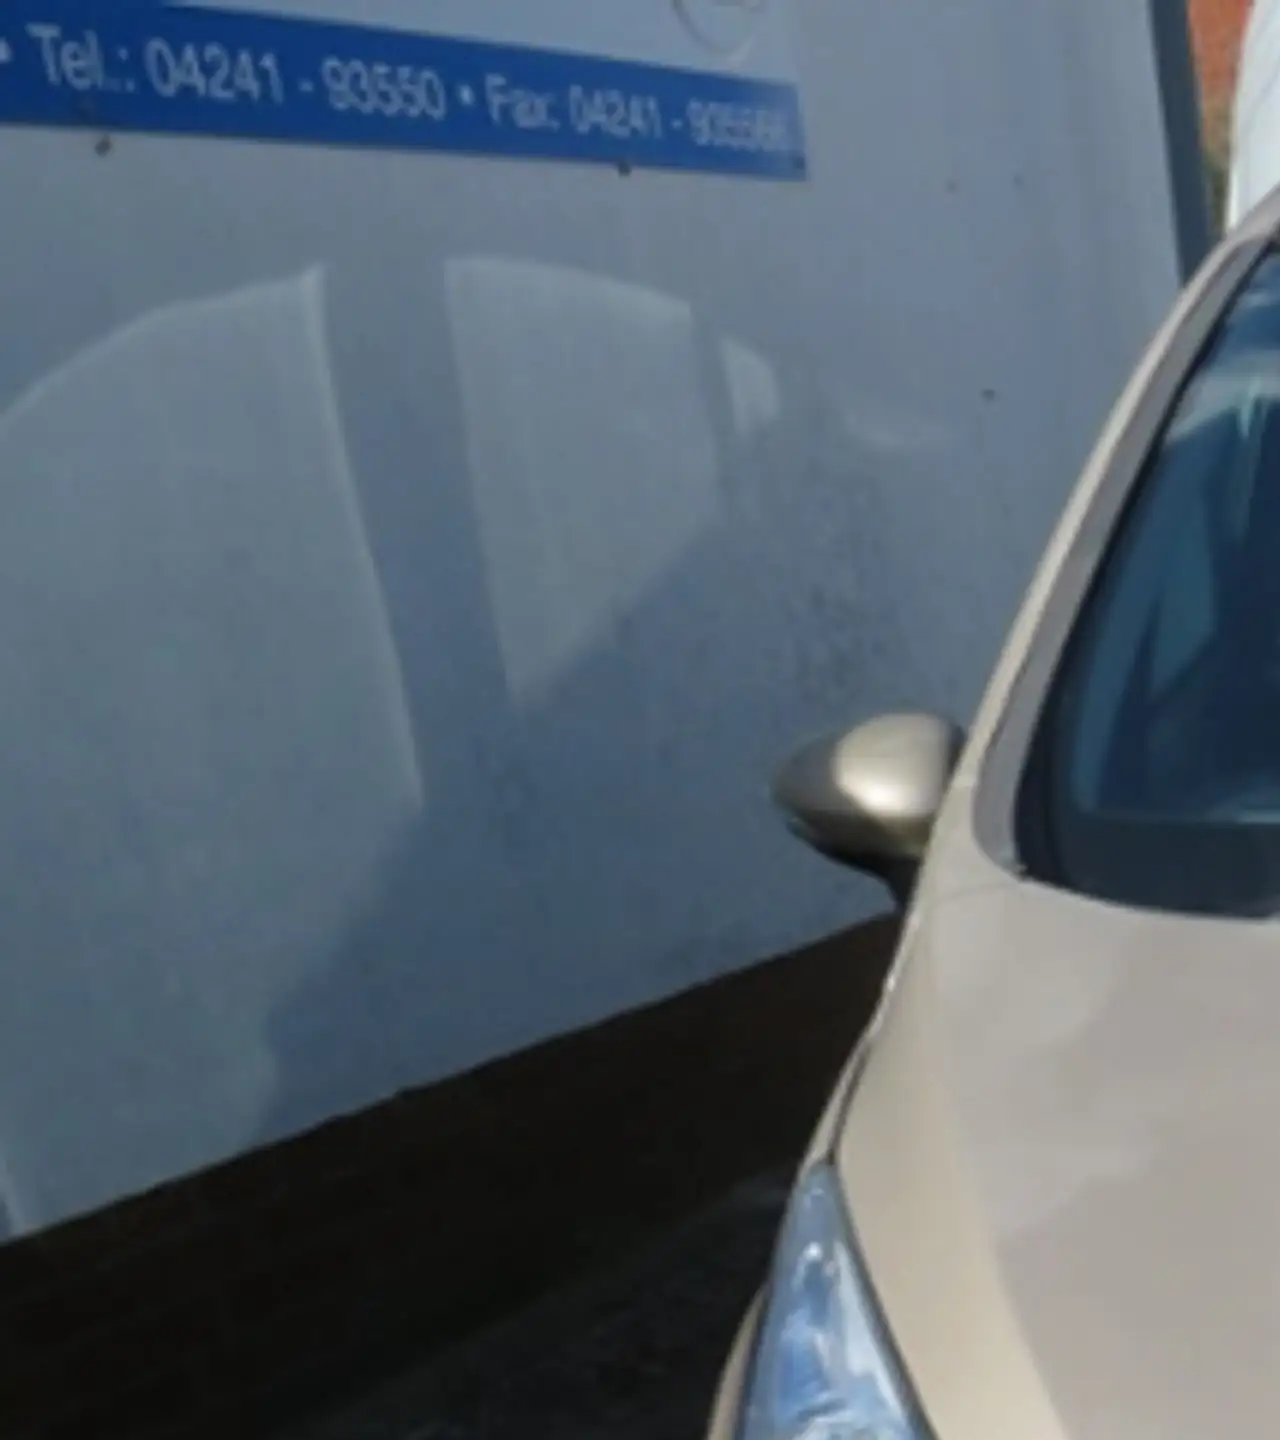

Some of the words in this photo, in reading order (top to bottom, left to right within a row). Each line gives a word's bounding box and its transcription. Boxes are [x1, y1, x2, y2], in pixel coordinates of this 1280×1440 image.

[25, 22, 136, 93] Tel.:
[145, 36, 284, 104] 04241
[321, 56, 446, 121] 93550
[568, 83, 662, 140] 04241
